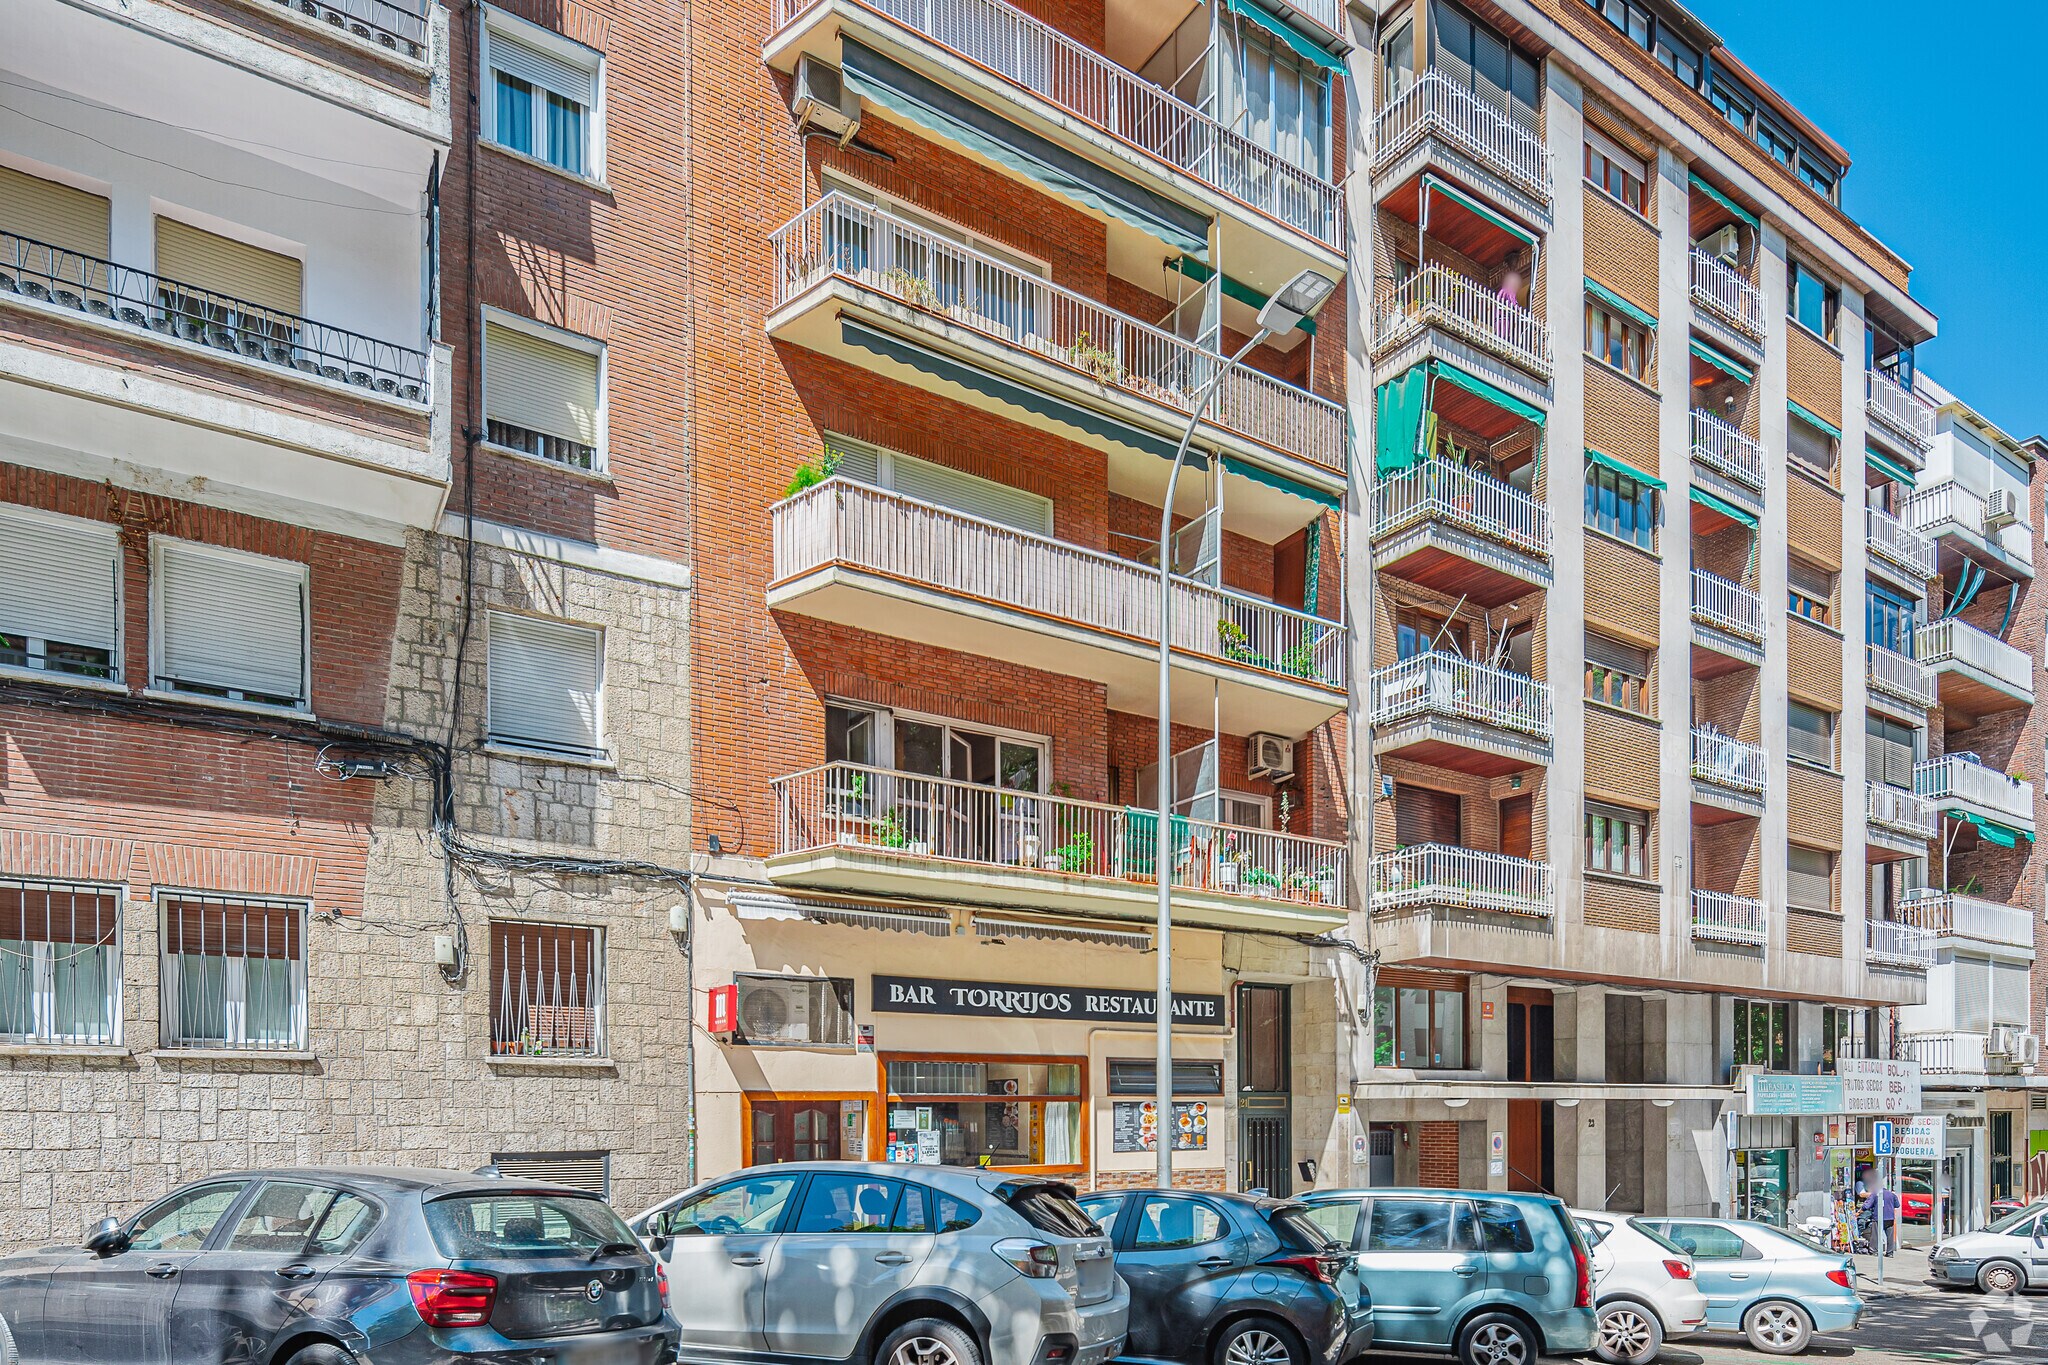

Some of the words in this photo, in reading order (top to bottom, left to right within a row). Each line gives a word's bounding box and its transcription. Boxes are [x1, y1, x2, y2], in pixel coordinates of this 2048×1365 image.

[889, 983, 936, 1005] BAR
[949, 987, 1072, 1015] TORRIJOS
[1085, 995, 1216, 1018] RESTAUANTE
[1866, 1080, 1883, 1092] SECOS
[1918, 1118, 1940, 1126] SECOS
[1895, 1127, 1931, 1135] BEBIDAS
